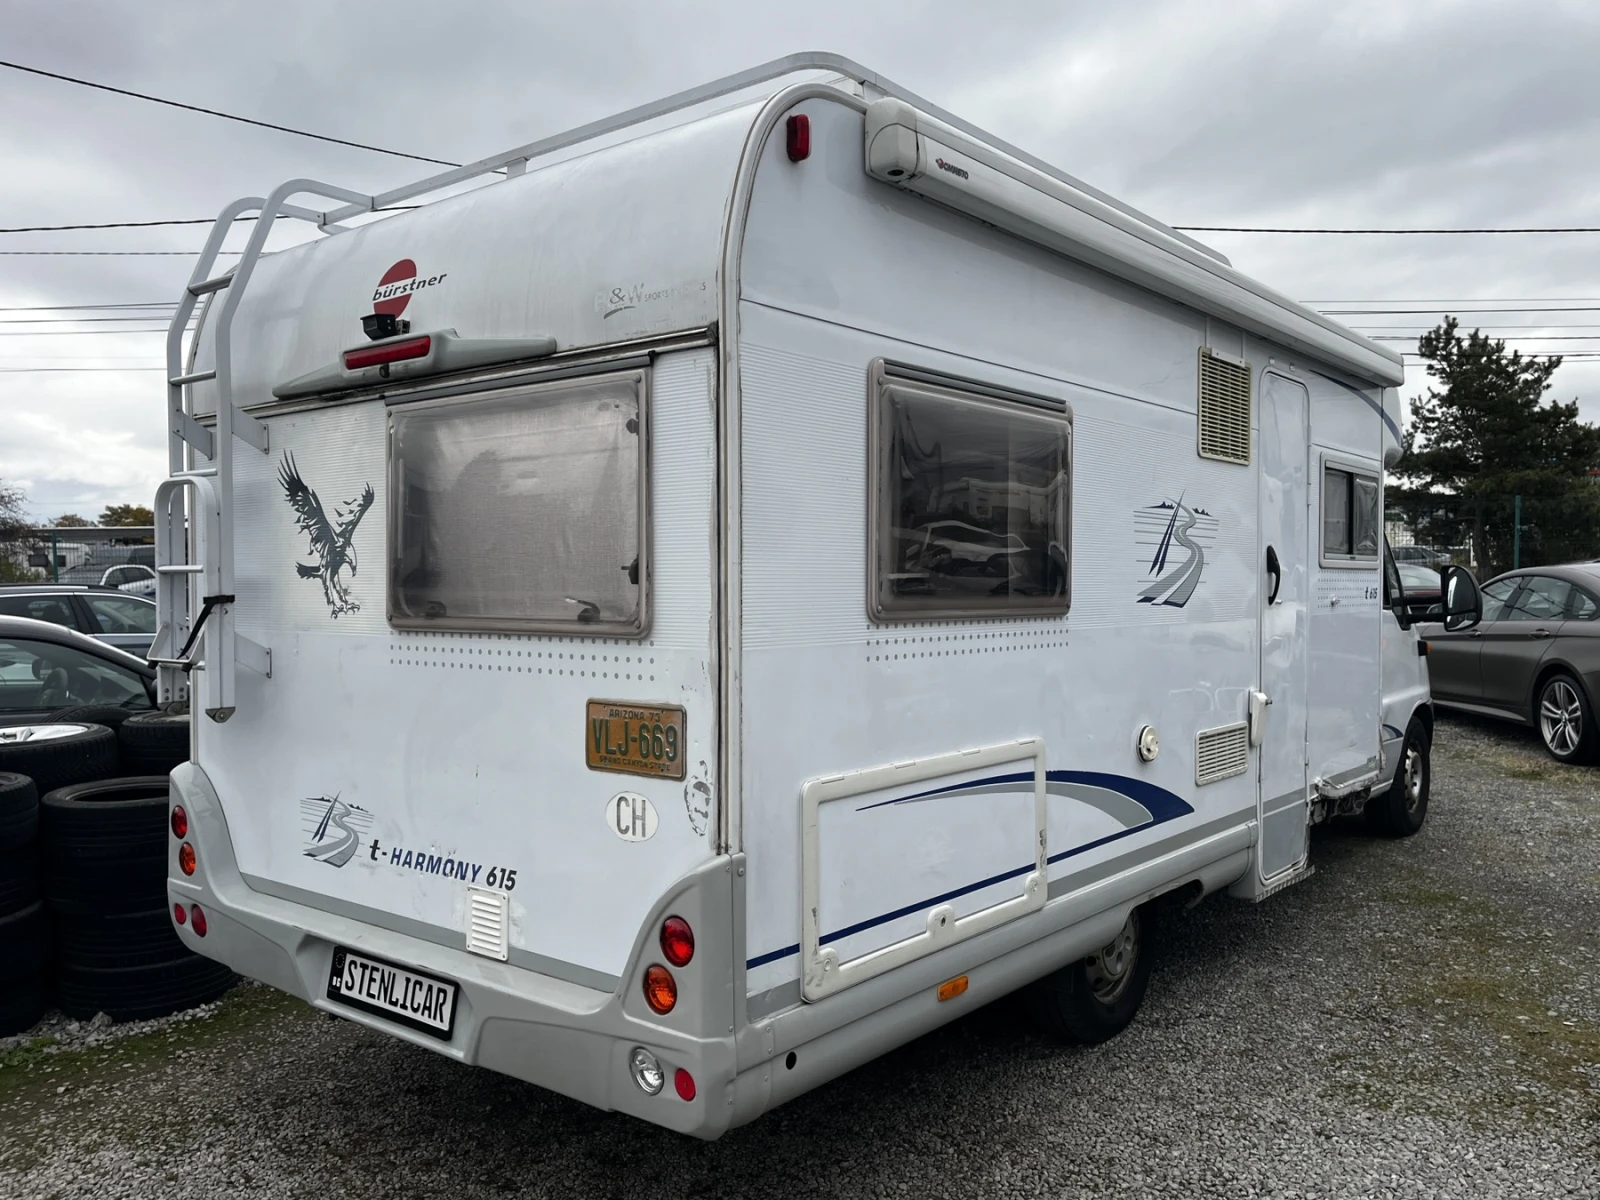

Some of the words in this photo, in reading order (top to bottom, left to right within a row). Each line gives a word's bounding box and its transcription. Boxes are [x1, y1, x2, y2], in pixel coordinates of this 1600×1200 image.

[372, 272, 448, 303] bürstner
[609, 709, 645, 721] ARIZONA
[649, 712, 661, 722] 73
[592, 717, 678, 762] VLJ-669
[616, 796, 647, 838] CH
[485, 866, 518, 891] 615
[344, 959, 448, 1024] STENLICAR
